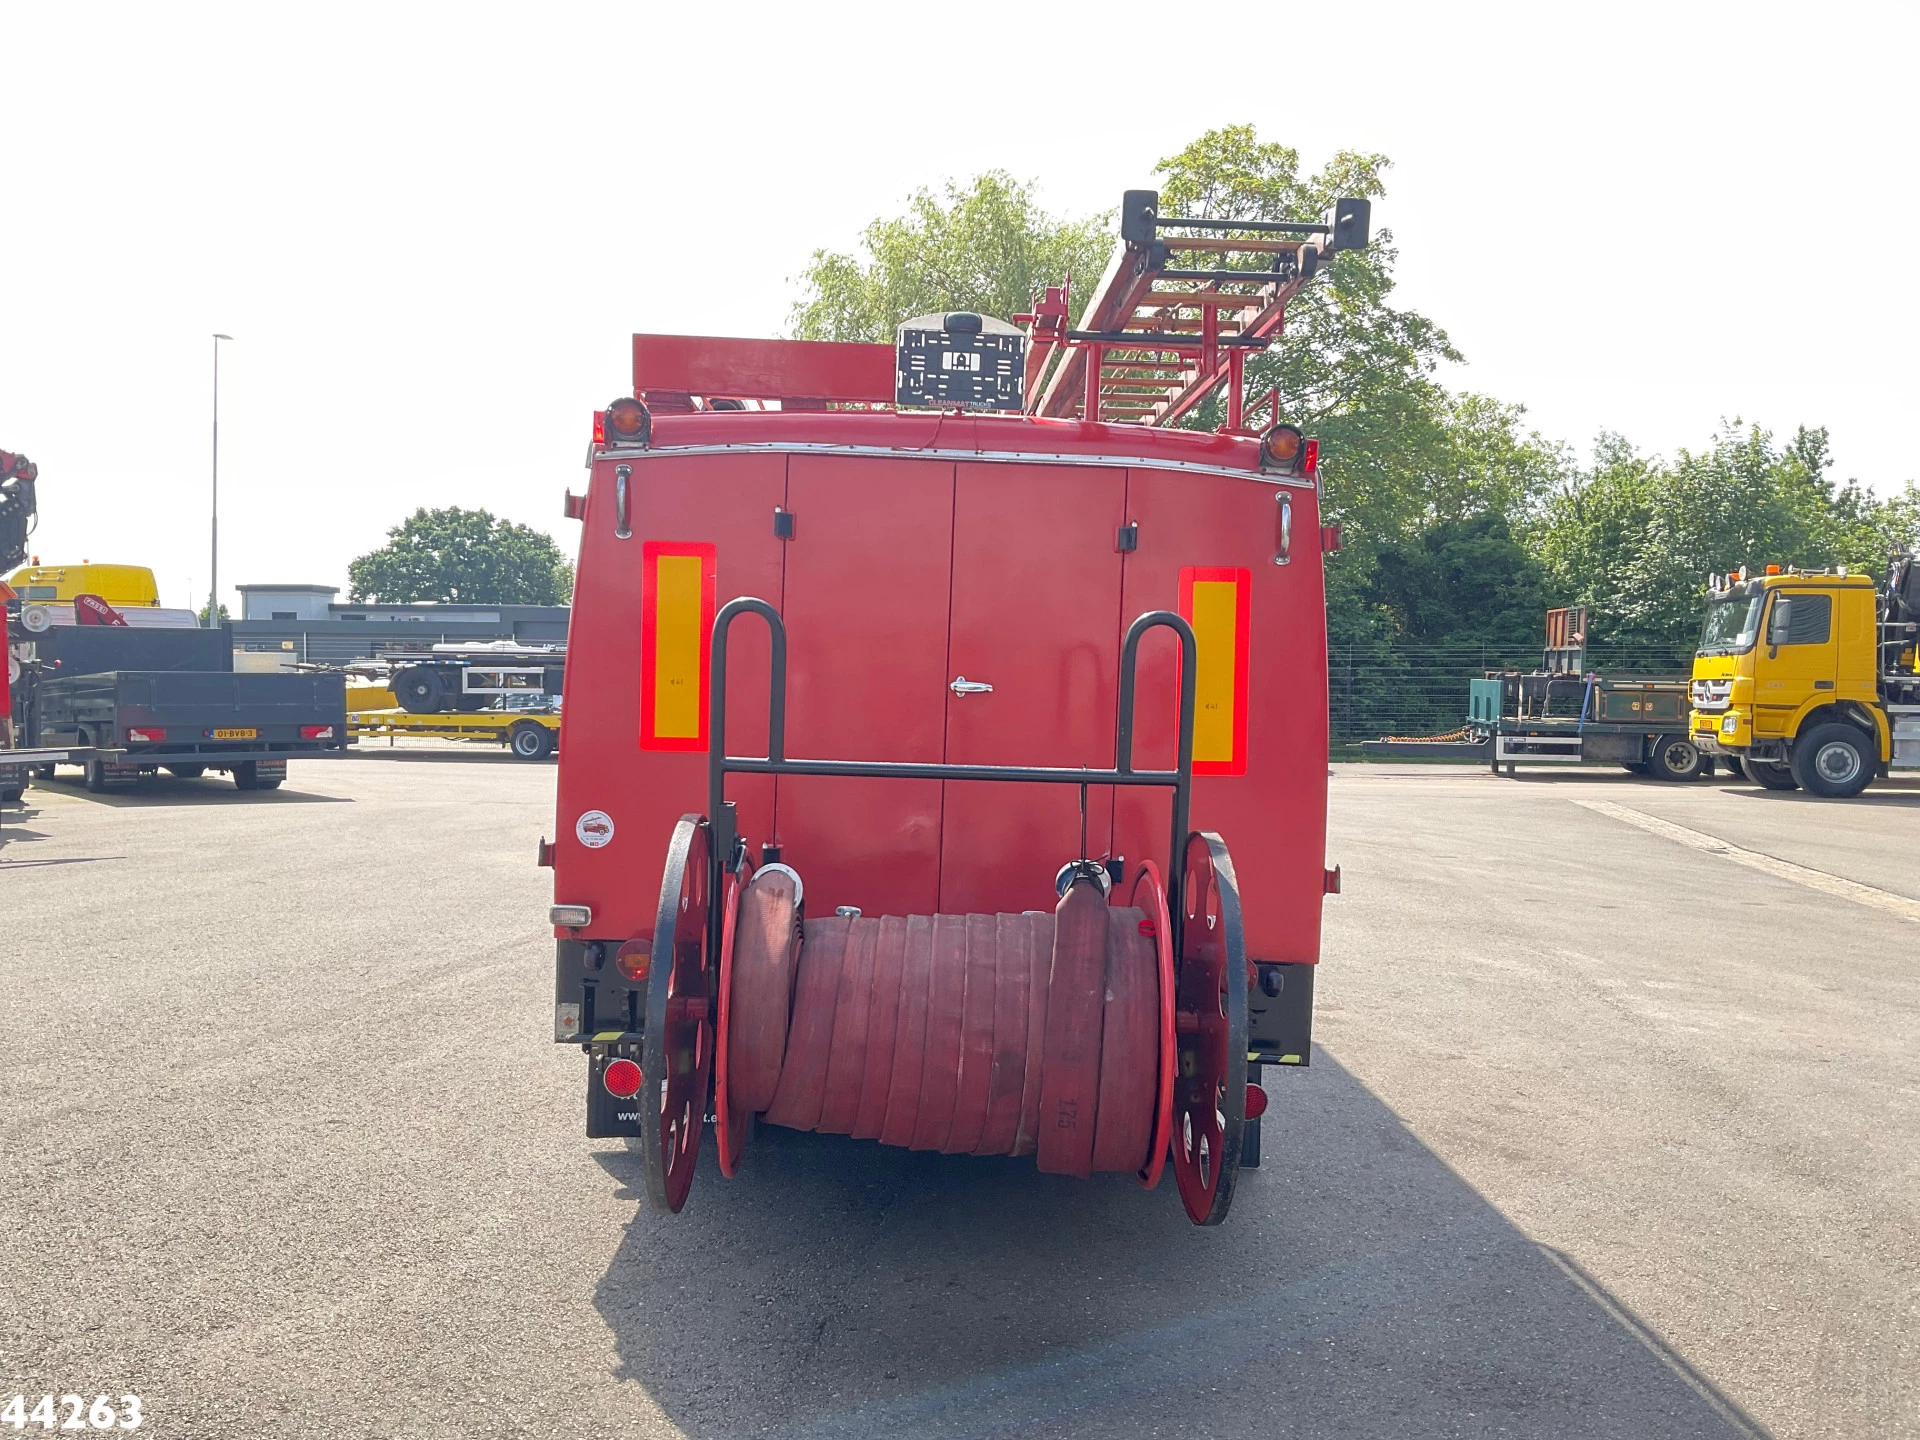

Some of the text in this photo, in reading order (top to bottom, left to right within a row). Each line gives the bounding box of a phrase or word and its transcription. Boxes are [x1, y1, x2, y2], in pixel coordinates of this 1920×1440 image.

[928, 399, 992, 409] CLEANMAT TRUCKS
[217, 729, 253, 738] 01-BVB-3
